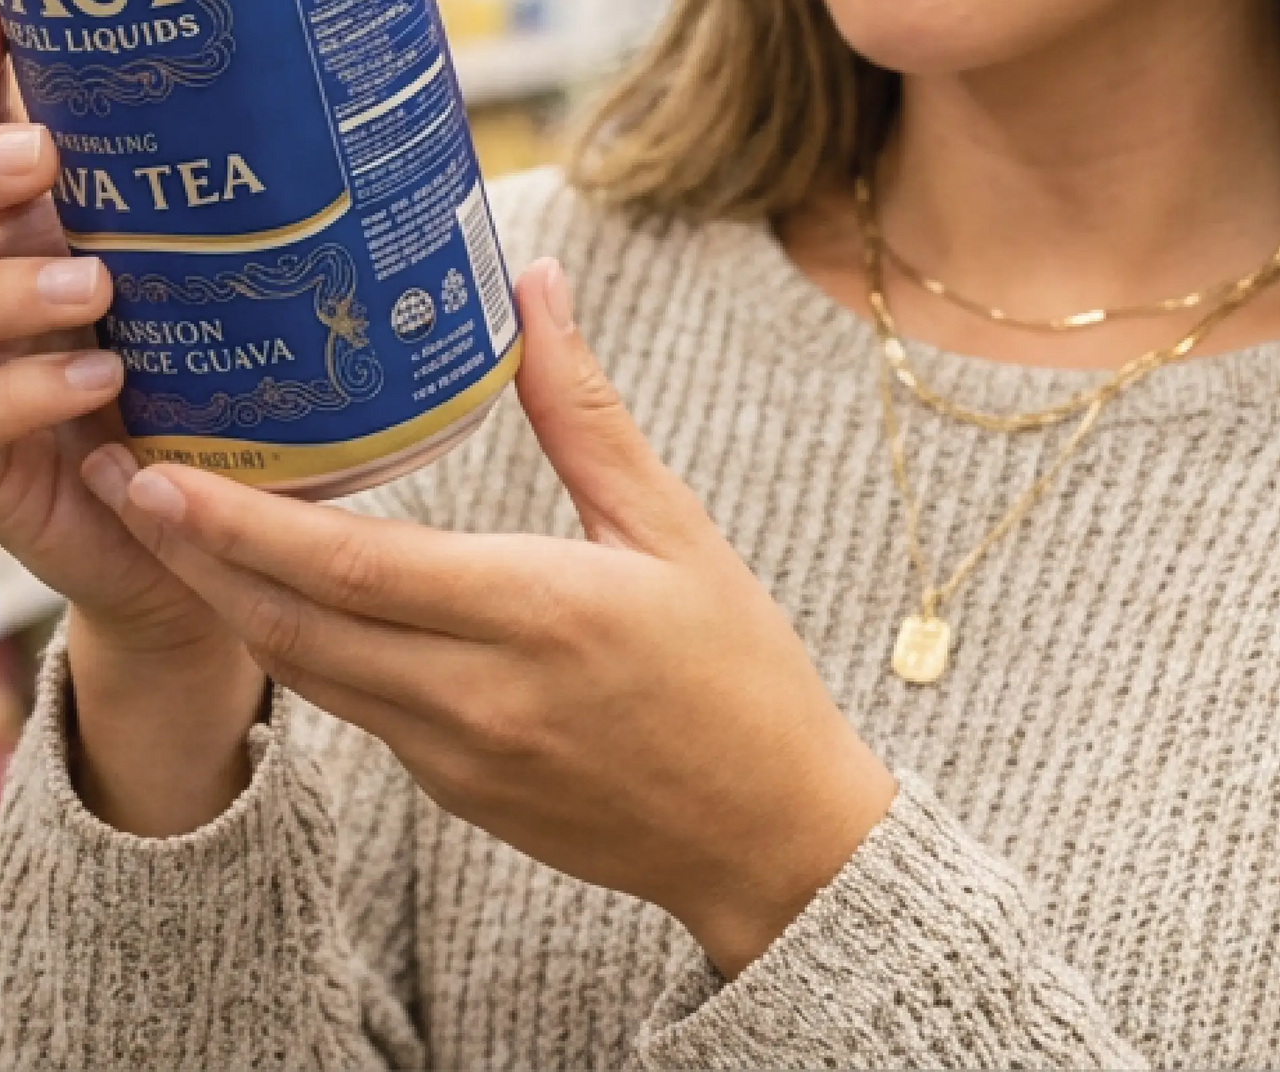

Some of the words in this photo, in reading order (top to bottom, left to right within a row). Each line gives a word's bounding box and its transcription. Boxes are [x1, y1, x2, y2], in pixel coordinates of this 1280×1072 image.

[65, 14, 200, 54] LIQUIDS
[133, 153, 267, 211] TEA
[185, 337, 296, 375] GUAVA
